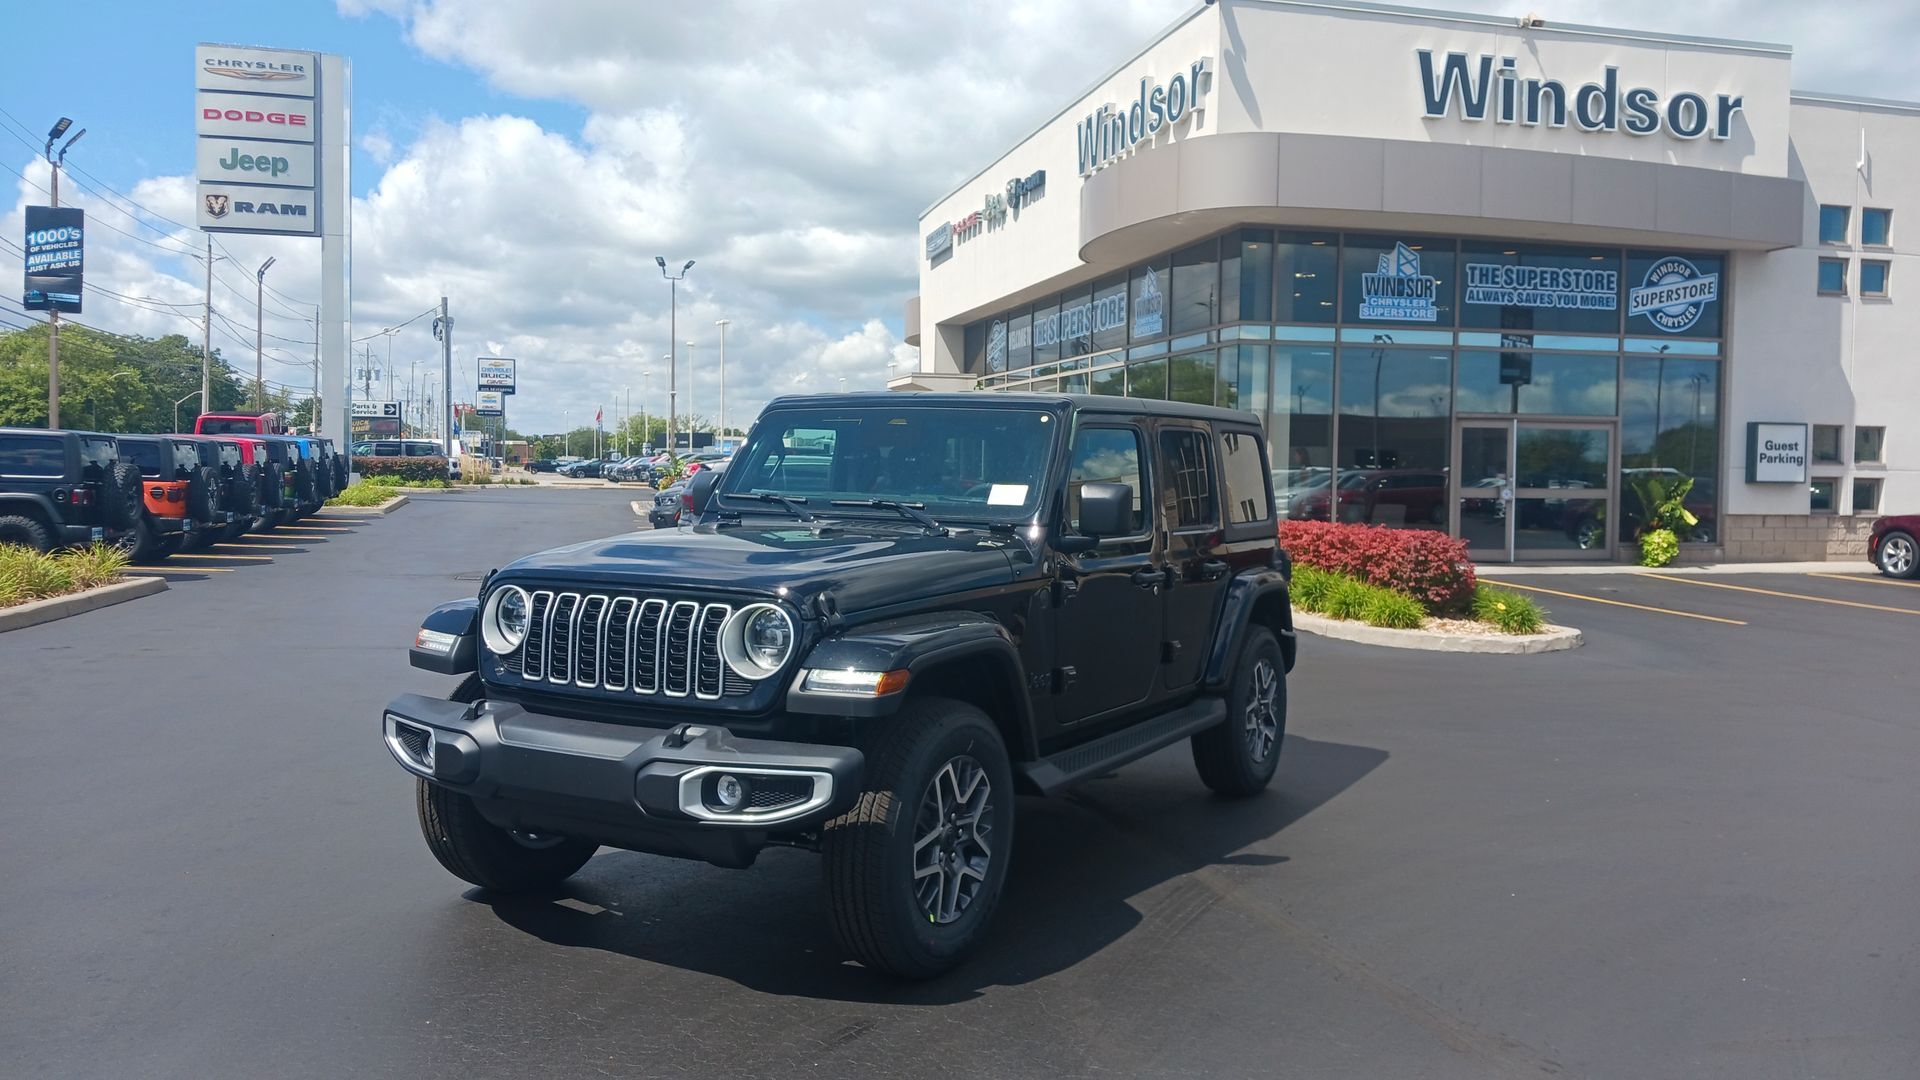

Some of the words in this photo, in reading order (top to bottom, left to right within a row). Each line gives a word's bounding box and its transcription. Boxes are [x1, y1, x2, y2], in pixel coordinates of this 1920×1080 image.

[205, 58, 304, 72] CHRYSLER
[1415, 48, 1744, 140] Windsor
[203, 108, 306, 126] DODGE
[1076, 56, 1214, 177] Windsor
[219, 147, 289, 177] Jeep
[234, 201, 307, 216] RAM
[28, 228, 81, 245] 1000's
[42, 241, 79, 250] VEHICLES
[28, 250, 81, 266] AVAILABLE
[28, 265, 48, 273] JUST
[1467, 265, 1500, 286] THE
[1503, 267, 1616, 291] SUPERSTORE
[1651, 262, 1691, 282] WINDSOR
[1364, 276, 1433, 298] WINDSOR
[1633, 281, 1714, 308] SUPERSTORE
[1370, 298, 1426, 307] CHRYSLER
[1467, 289, 1514, 304] ALWAYS
[1516, 291, 1552, 306] SAVES
[1556, 293, 1578, 307] YOU
[1580, 294, 1616, 309] MORE!
[1047, 293, 1126, 344] SUPERSTORE
[1362, 307, 1433, 318] SUPERSTORE
[1656, 305, 1697, 327] CHRYSLER
[1765, 440, 1799, 451] Guest
[1759, 453, 1803, 466] Parking
